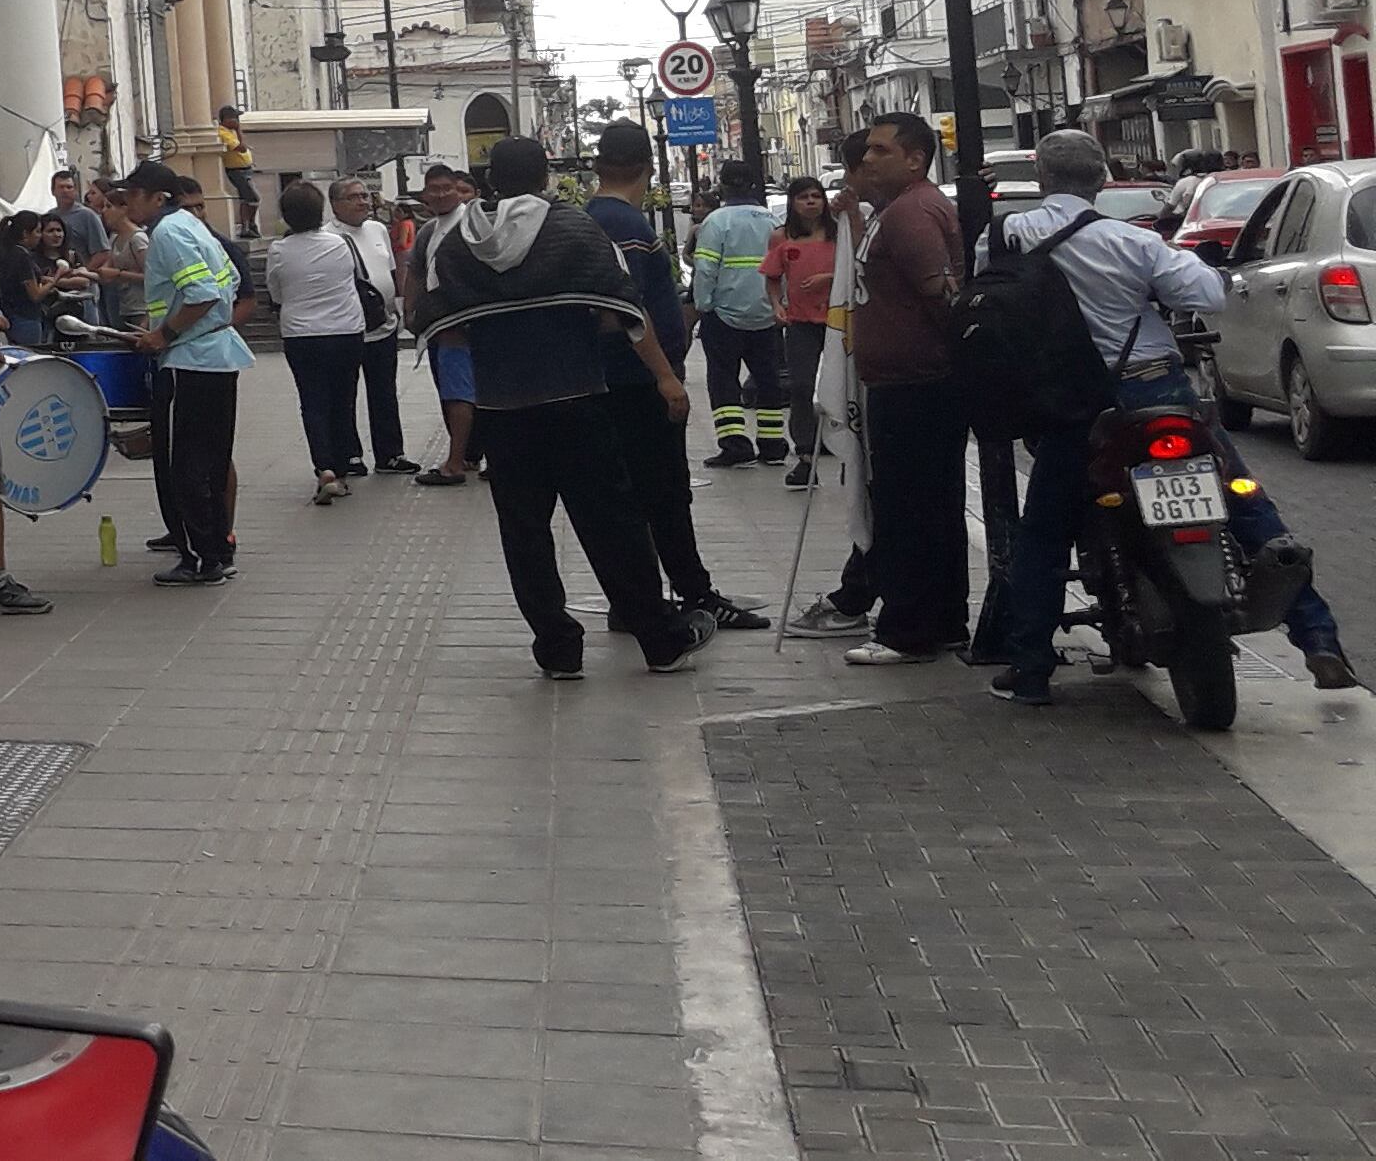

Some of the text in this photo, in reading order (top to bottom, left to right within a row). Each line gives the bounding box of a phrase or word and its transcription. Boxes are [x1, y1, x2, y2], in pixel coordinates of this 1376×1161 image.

[670, 54, 704, 75] 20
[1155, 476, 1201, 499] A03
[1151, 497, 1213, 521] 8GTT
